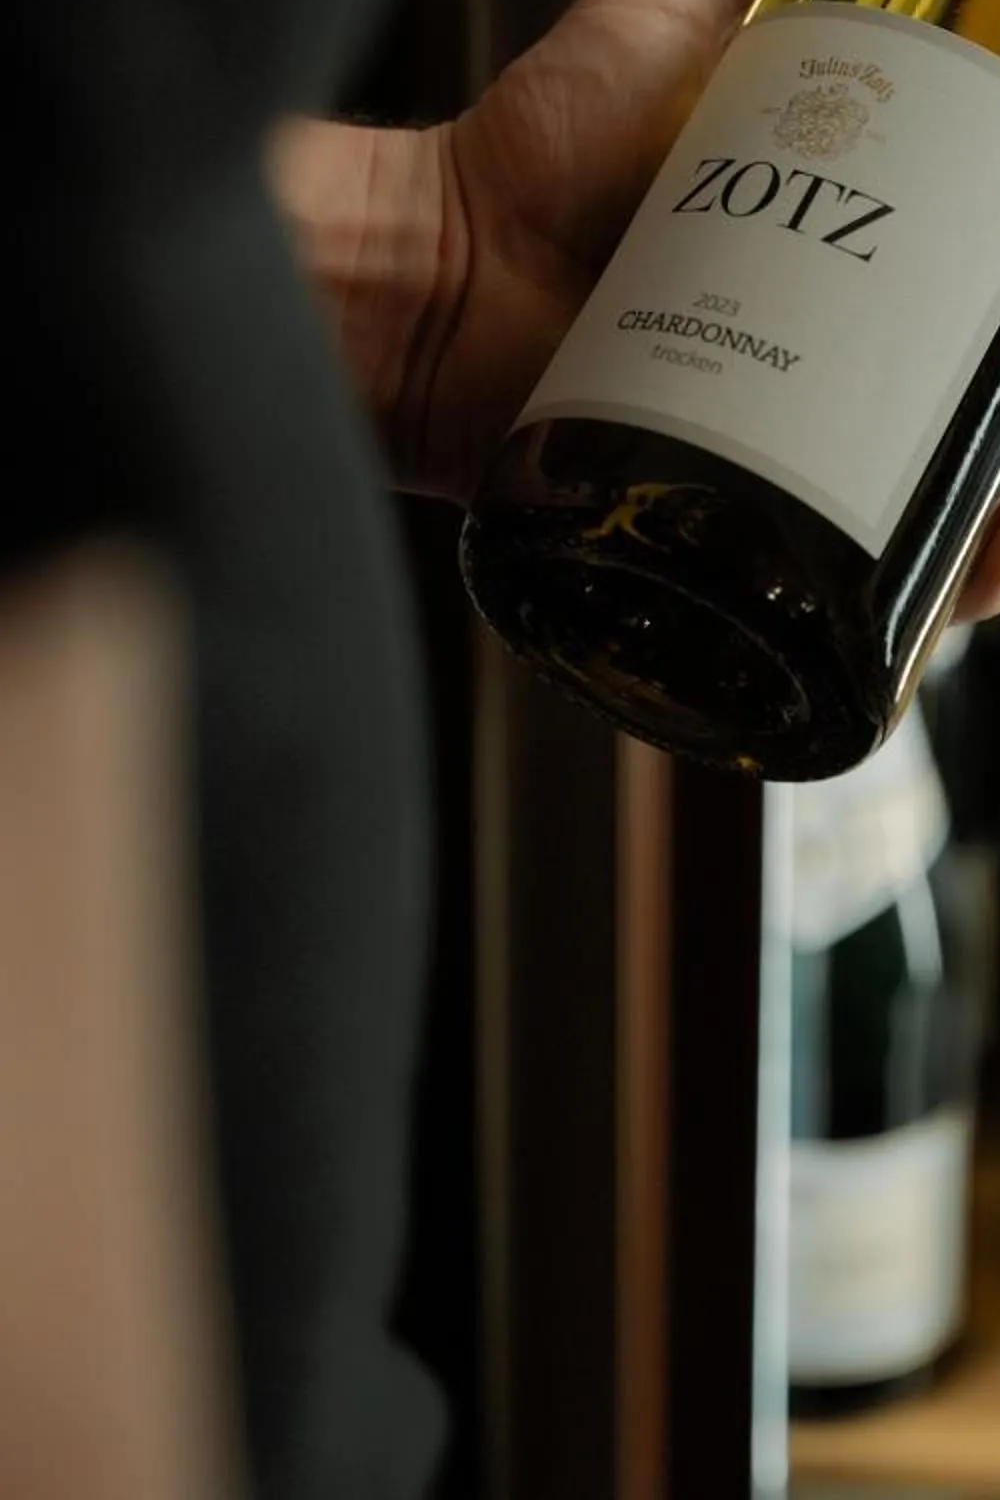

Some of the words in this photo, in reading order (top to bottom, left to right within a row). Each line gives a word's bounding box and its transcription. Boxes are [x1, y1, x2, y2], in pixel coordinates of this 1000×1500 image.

[672, 158, 895, 262] ZOTZ
[692, 292, 741, 317] 2023
[617, 309, 800, 373] CHARDONNAY
[652, 343, 723, 375] trocken
